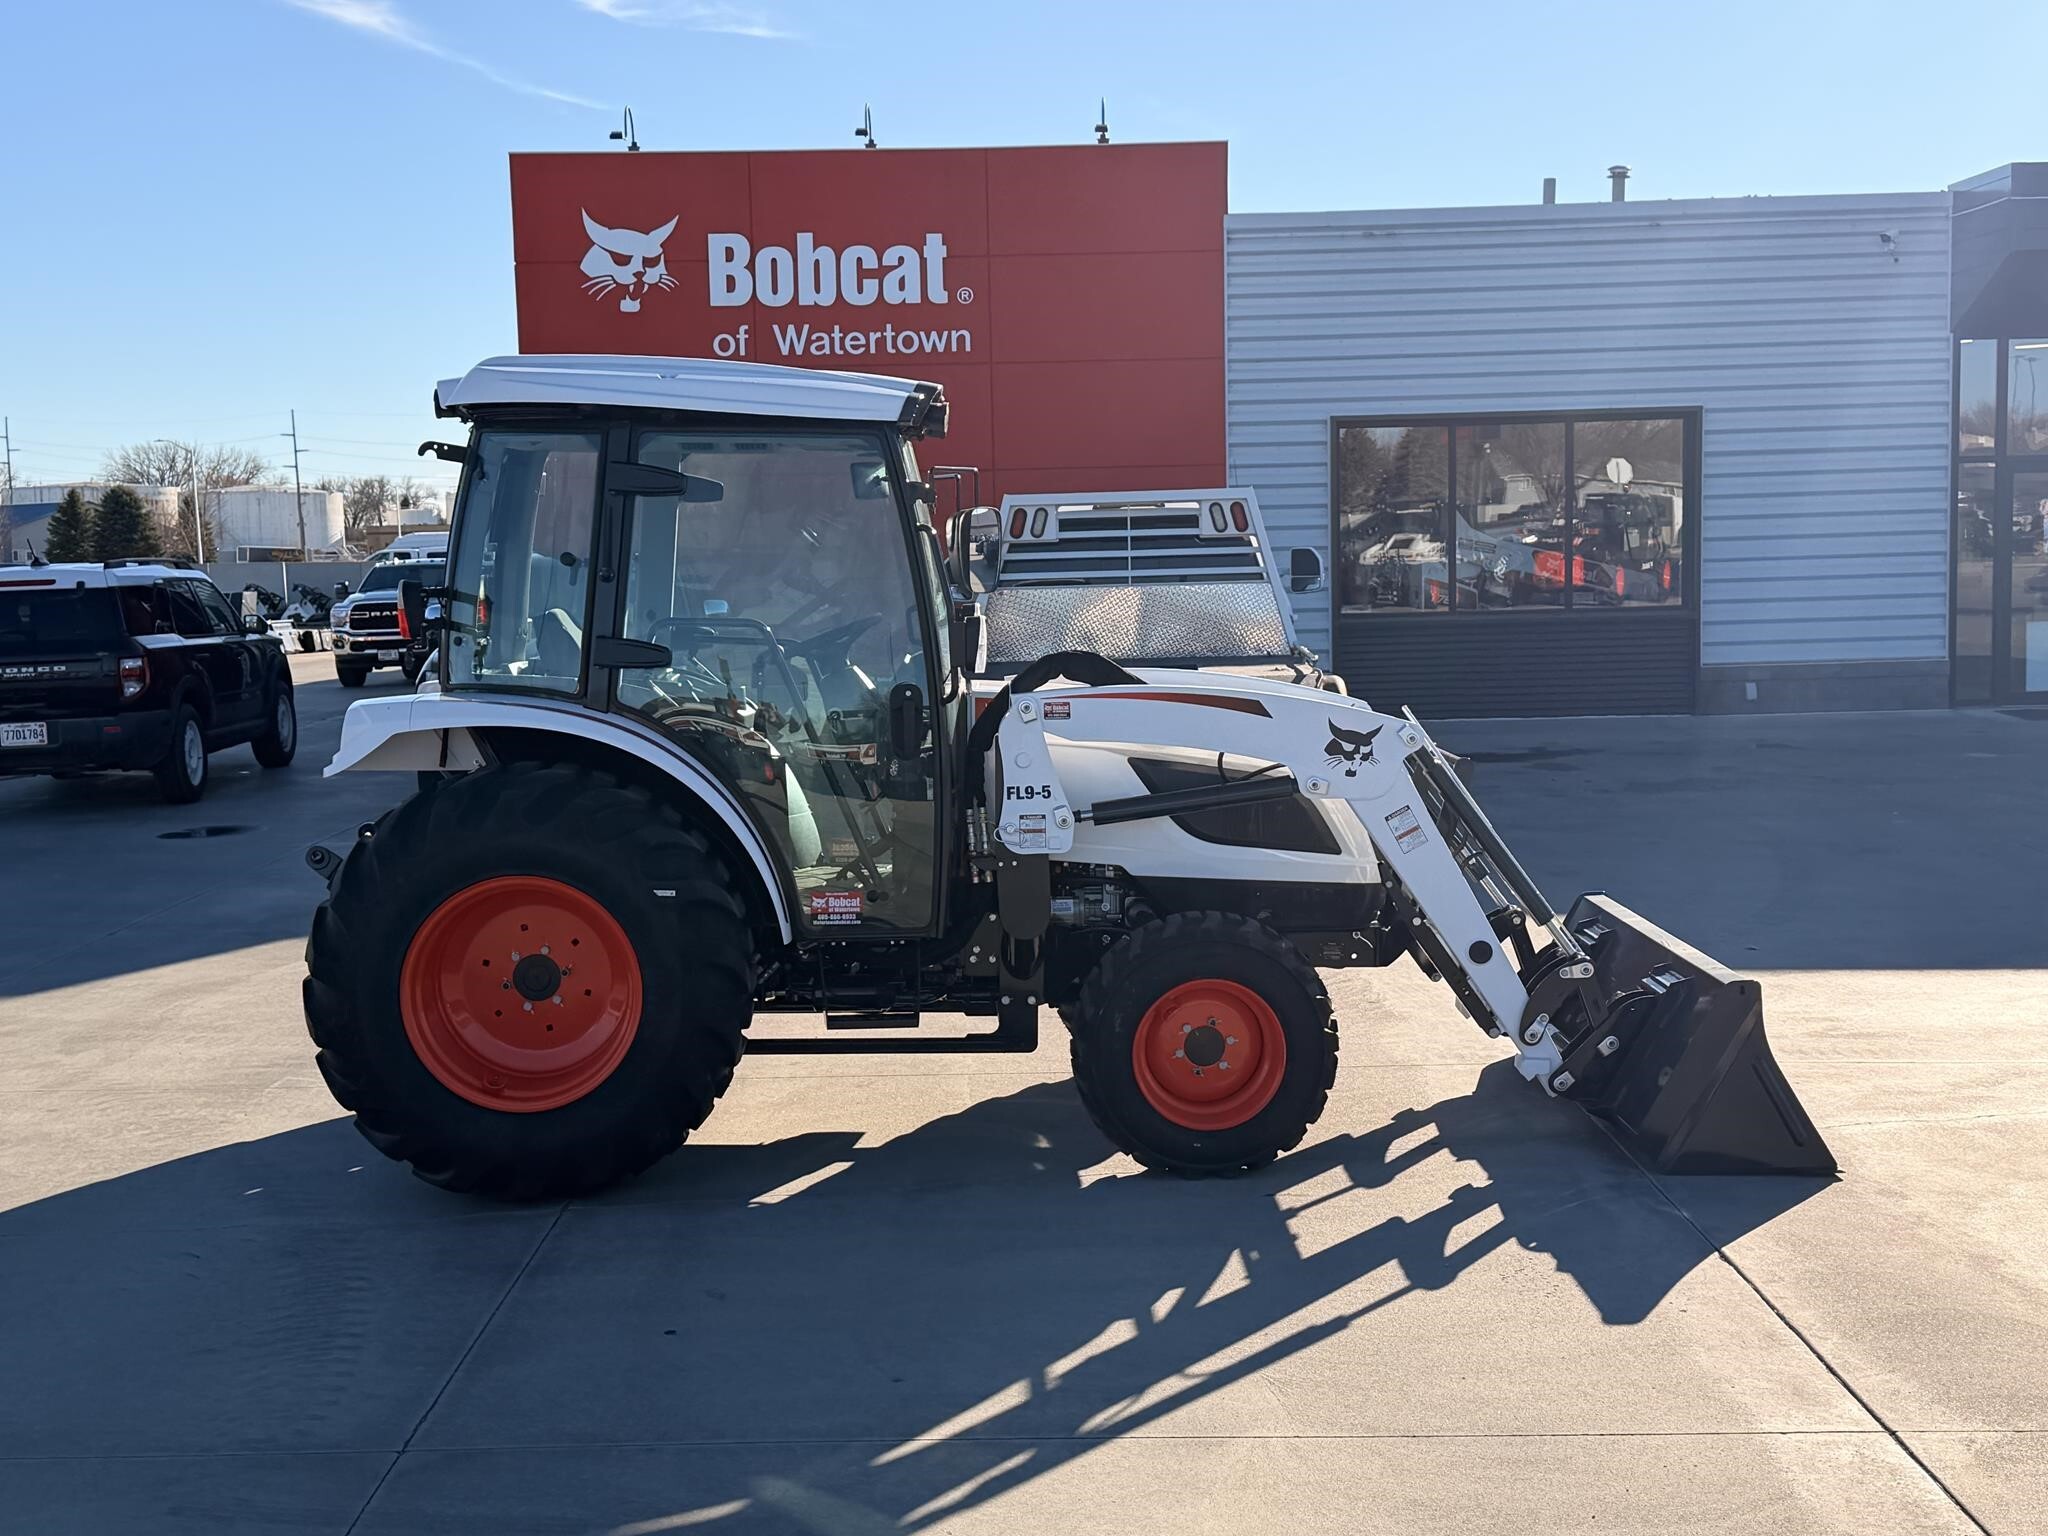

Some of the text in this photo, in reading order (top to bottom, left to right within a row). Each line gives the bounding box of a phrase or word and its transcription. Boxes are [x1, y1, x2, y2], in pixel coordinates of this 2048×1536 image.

[707, 232, 949, 308] Bobcat
[712, 323, 972, 357] of Watertown
[1006, 785, 1052, 801] FL9-5
[828, 897, 861, 907] Bobcat
